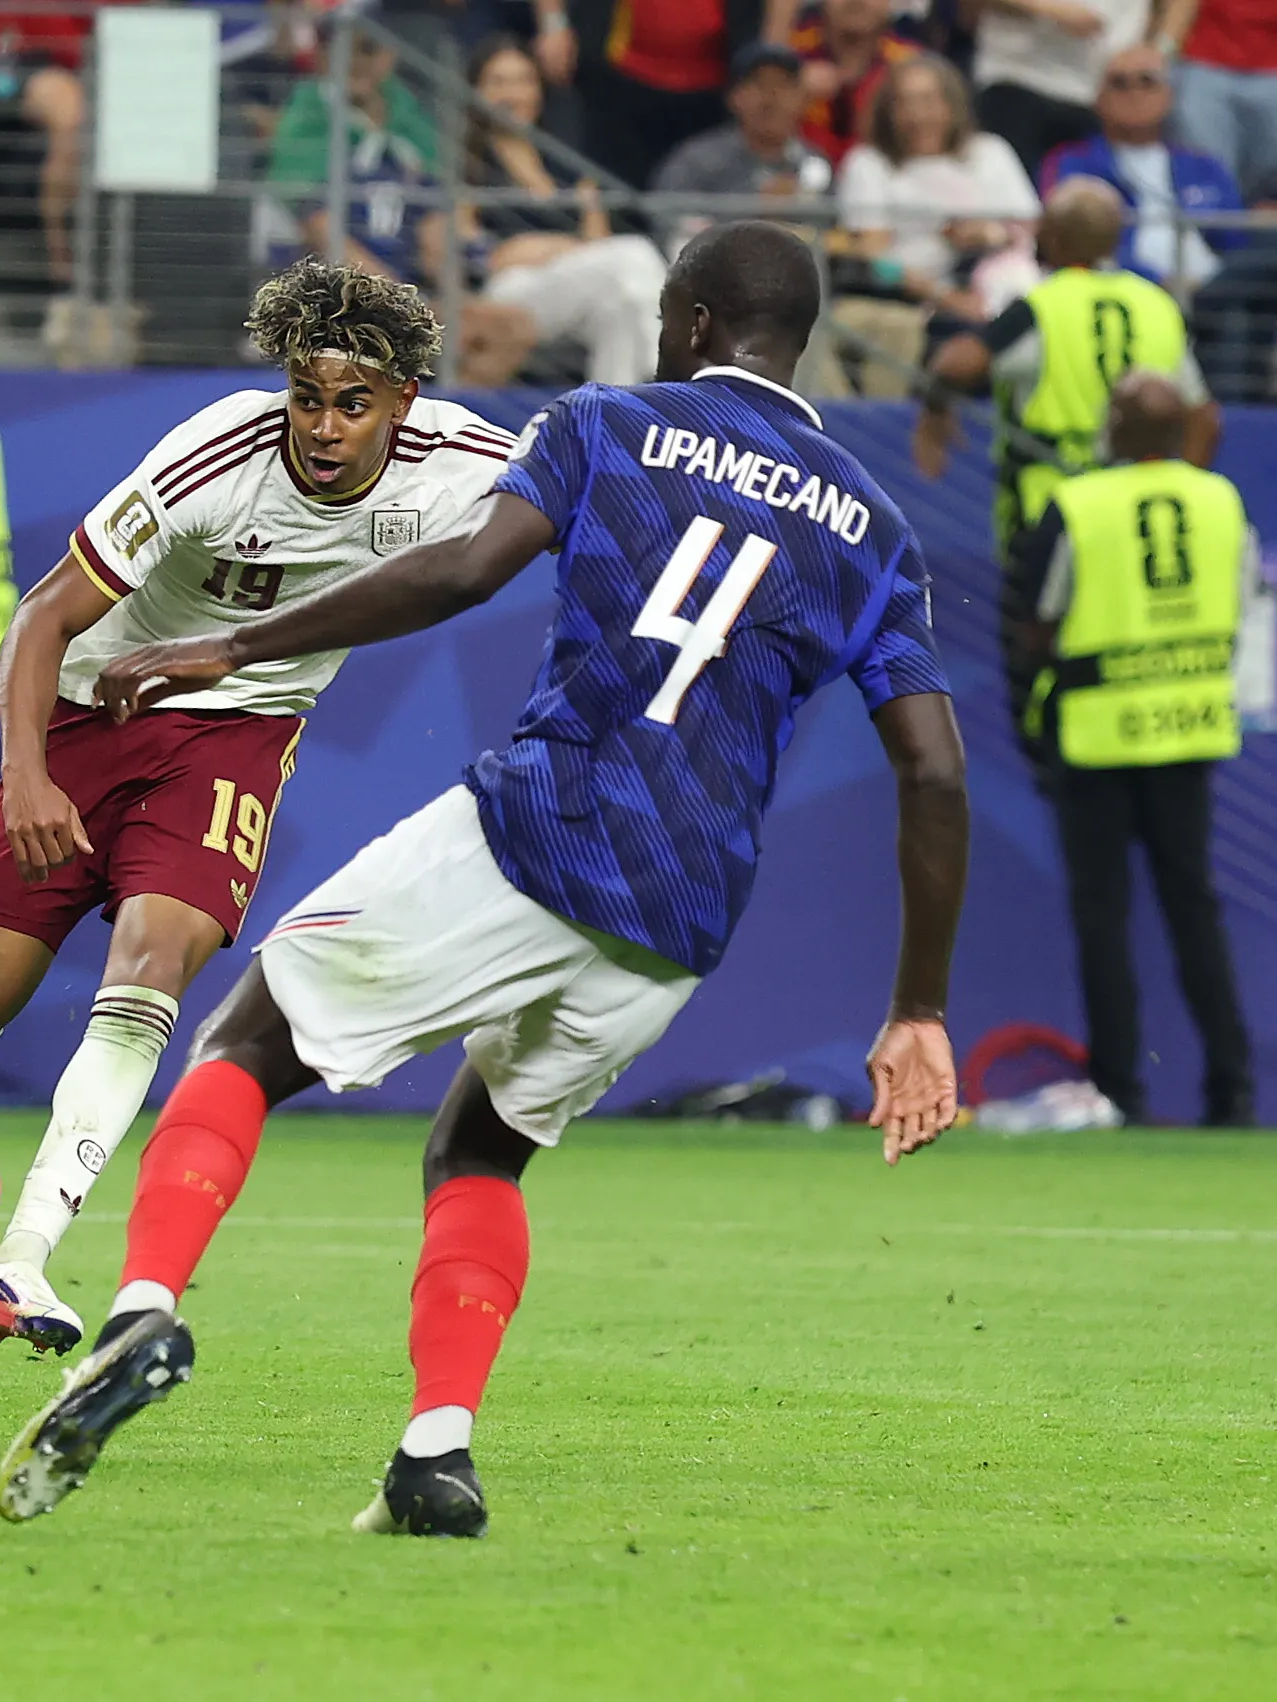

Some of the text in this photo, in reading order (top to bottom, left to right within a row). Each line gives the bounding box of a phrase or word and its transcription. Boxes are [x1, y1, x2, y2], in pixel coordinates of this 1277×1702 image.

[641, 424, 871, 546] UPAMECANO
[201, 557, 286, 611] 19
[630, 514, 779, 725] 4
[201, 778, 267, 873] 19
